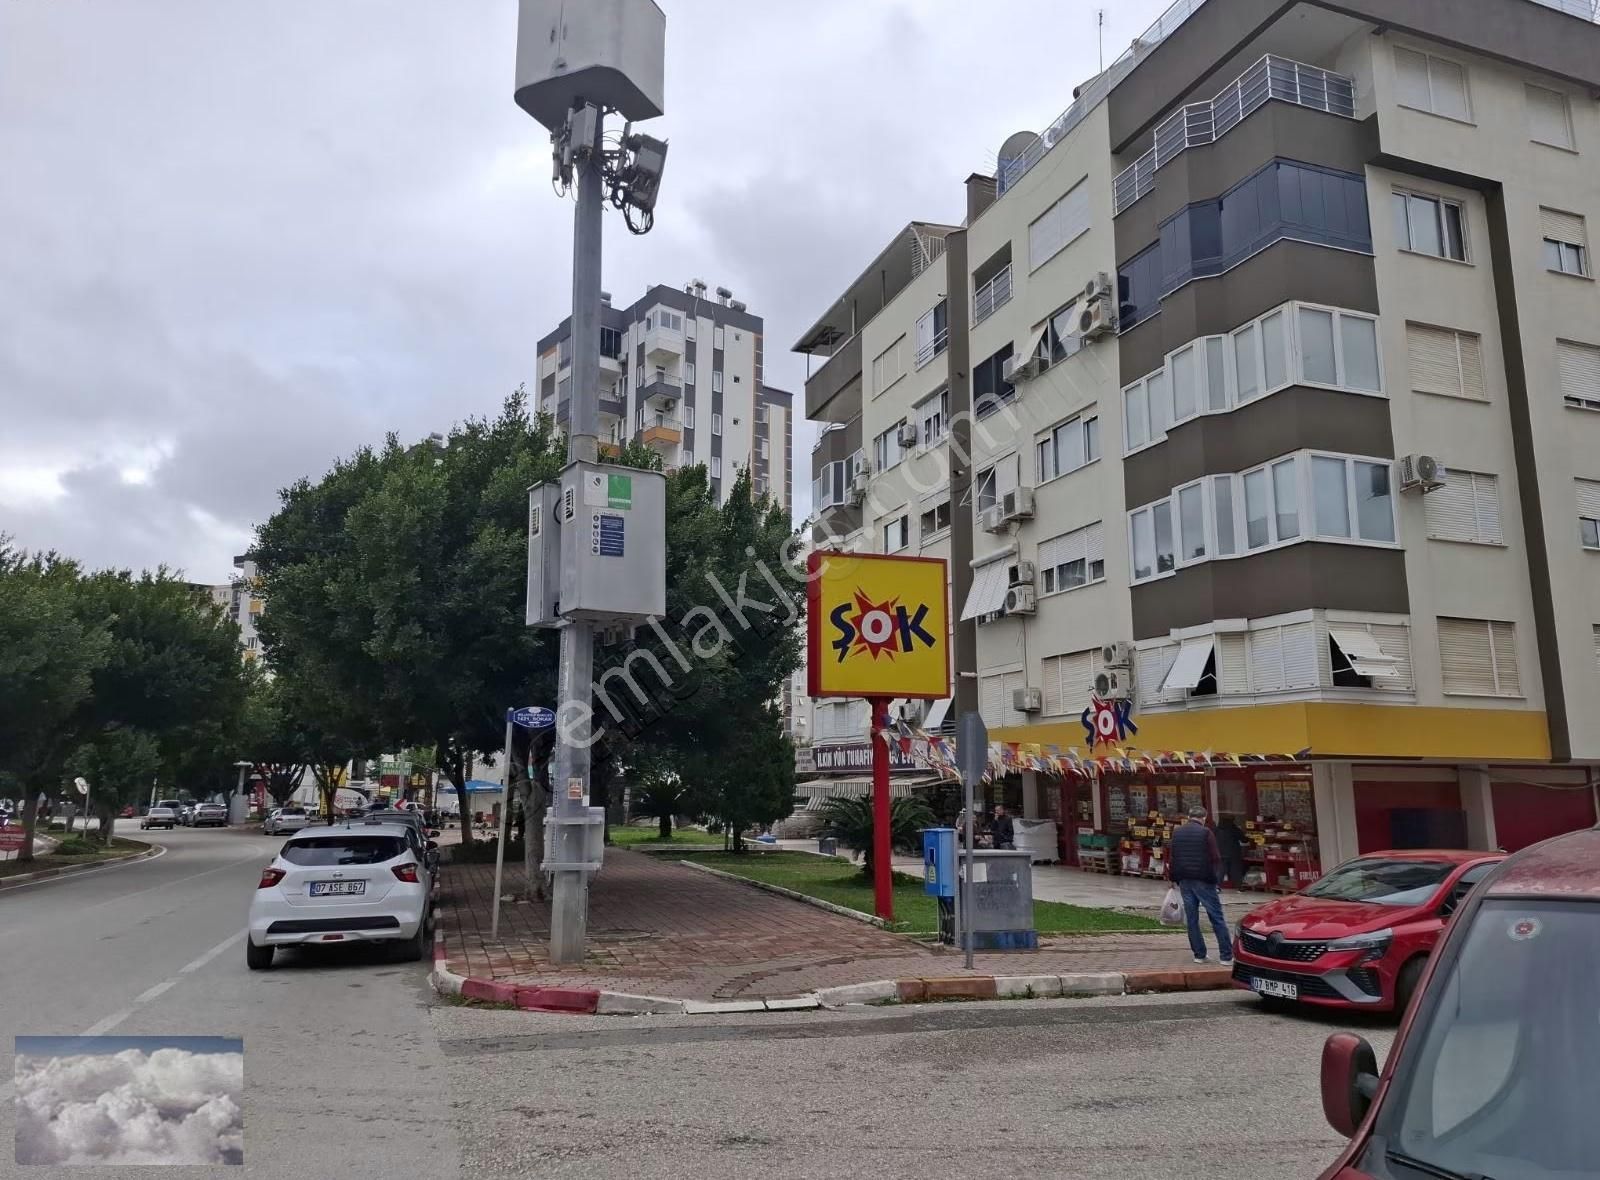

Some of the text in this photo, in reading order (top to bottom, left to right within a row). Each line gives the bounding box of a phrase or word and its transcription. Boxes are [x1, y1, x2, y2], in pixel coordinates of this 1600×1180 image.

[829, 602, 938, 663] ŞOK
[1081, 697, 1139, 754] ŞOK
[316, 882, 363, 892] 07 ASE 867
[1254, 978, 1262, 988] 07
[1265, 980, 1279, 991] BMP
[1282, 983, 1296, 996] 416
